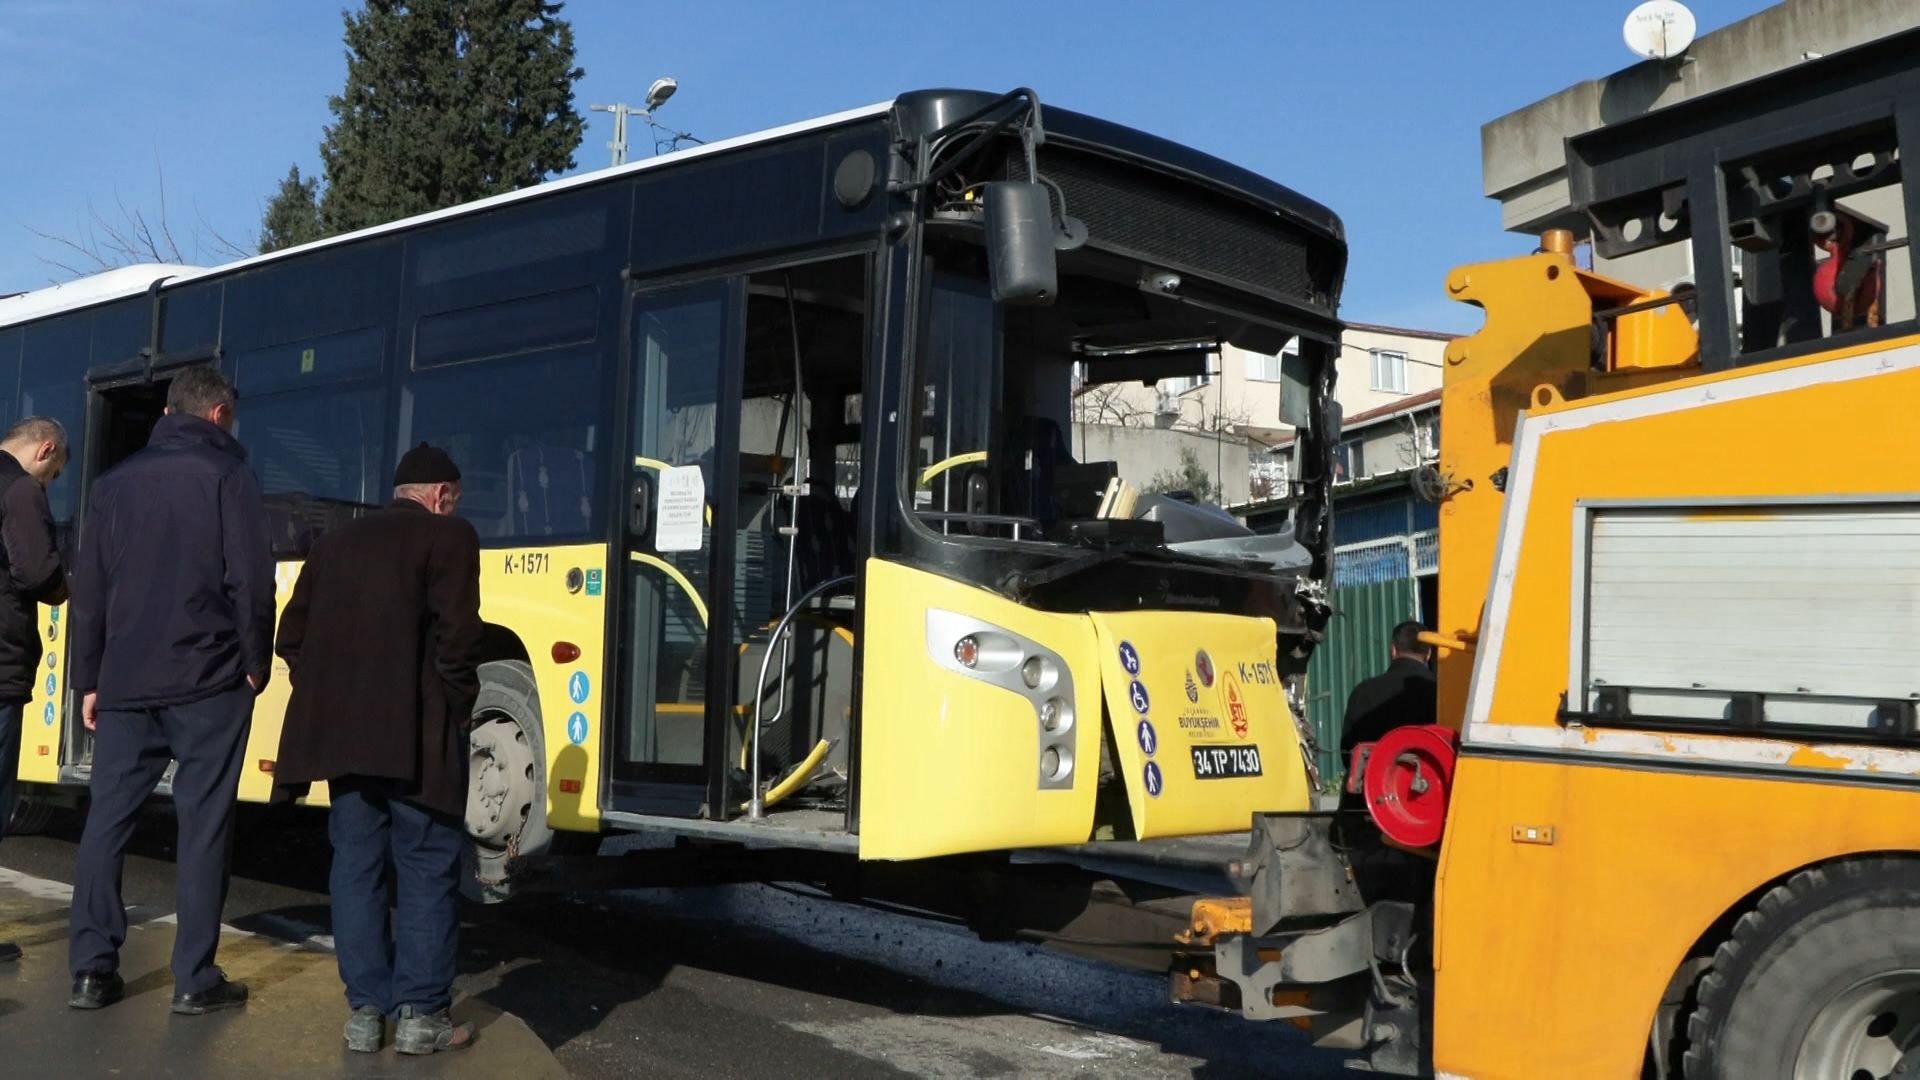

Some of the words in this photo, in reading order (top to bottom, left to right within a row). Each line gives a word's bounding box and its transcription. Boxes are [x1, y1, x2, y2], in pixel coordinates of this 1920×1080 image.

[504, 553, 549, 574] K-1571
[1237, 659, 1276, 684] K-1571
[1195, 750, 1212, 774] 34
[1211, 749, 1228, 774] TP
[1230, 748, 1260, 773] 7430
